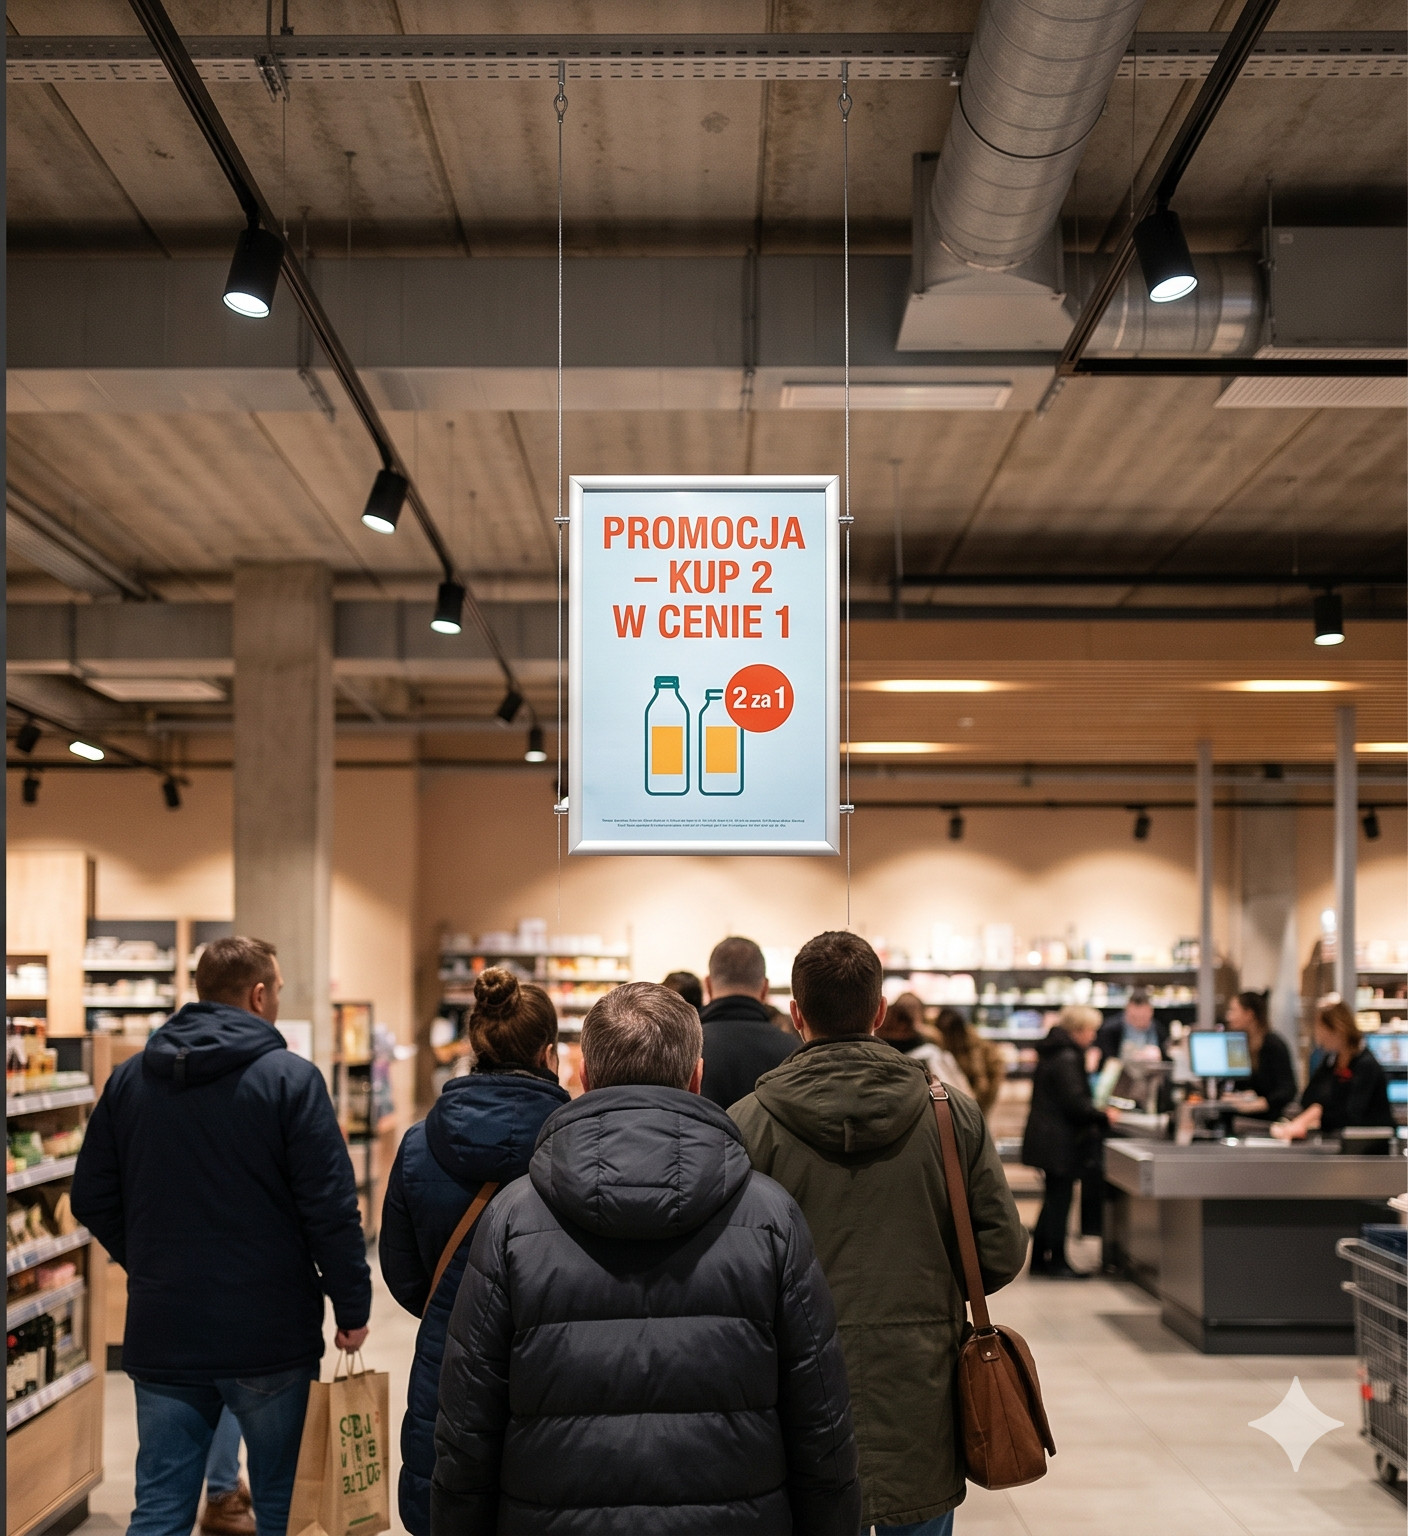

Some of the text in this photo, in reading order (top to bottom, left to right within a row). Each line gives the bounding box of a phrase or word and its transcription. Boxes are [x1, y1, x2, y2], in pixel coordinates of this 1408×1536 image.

[603, 516, 805, 550] PROMOCJA
[669, 560, 740, 594] KUP
[751, 561, 773, 594] 2
[613, 604, 789, 639] W CENIE 1
[732, 686, 785, 709] 2 za 1
